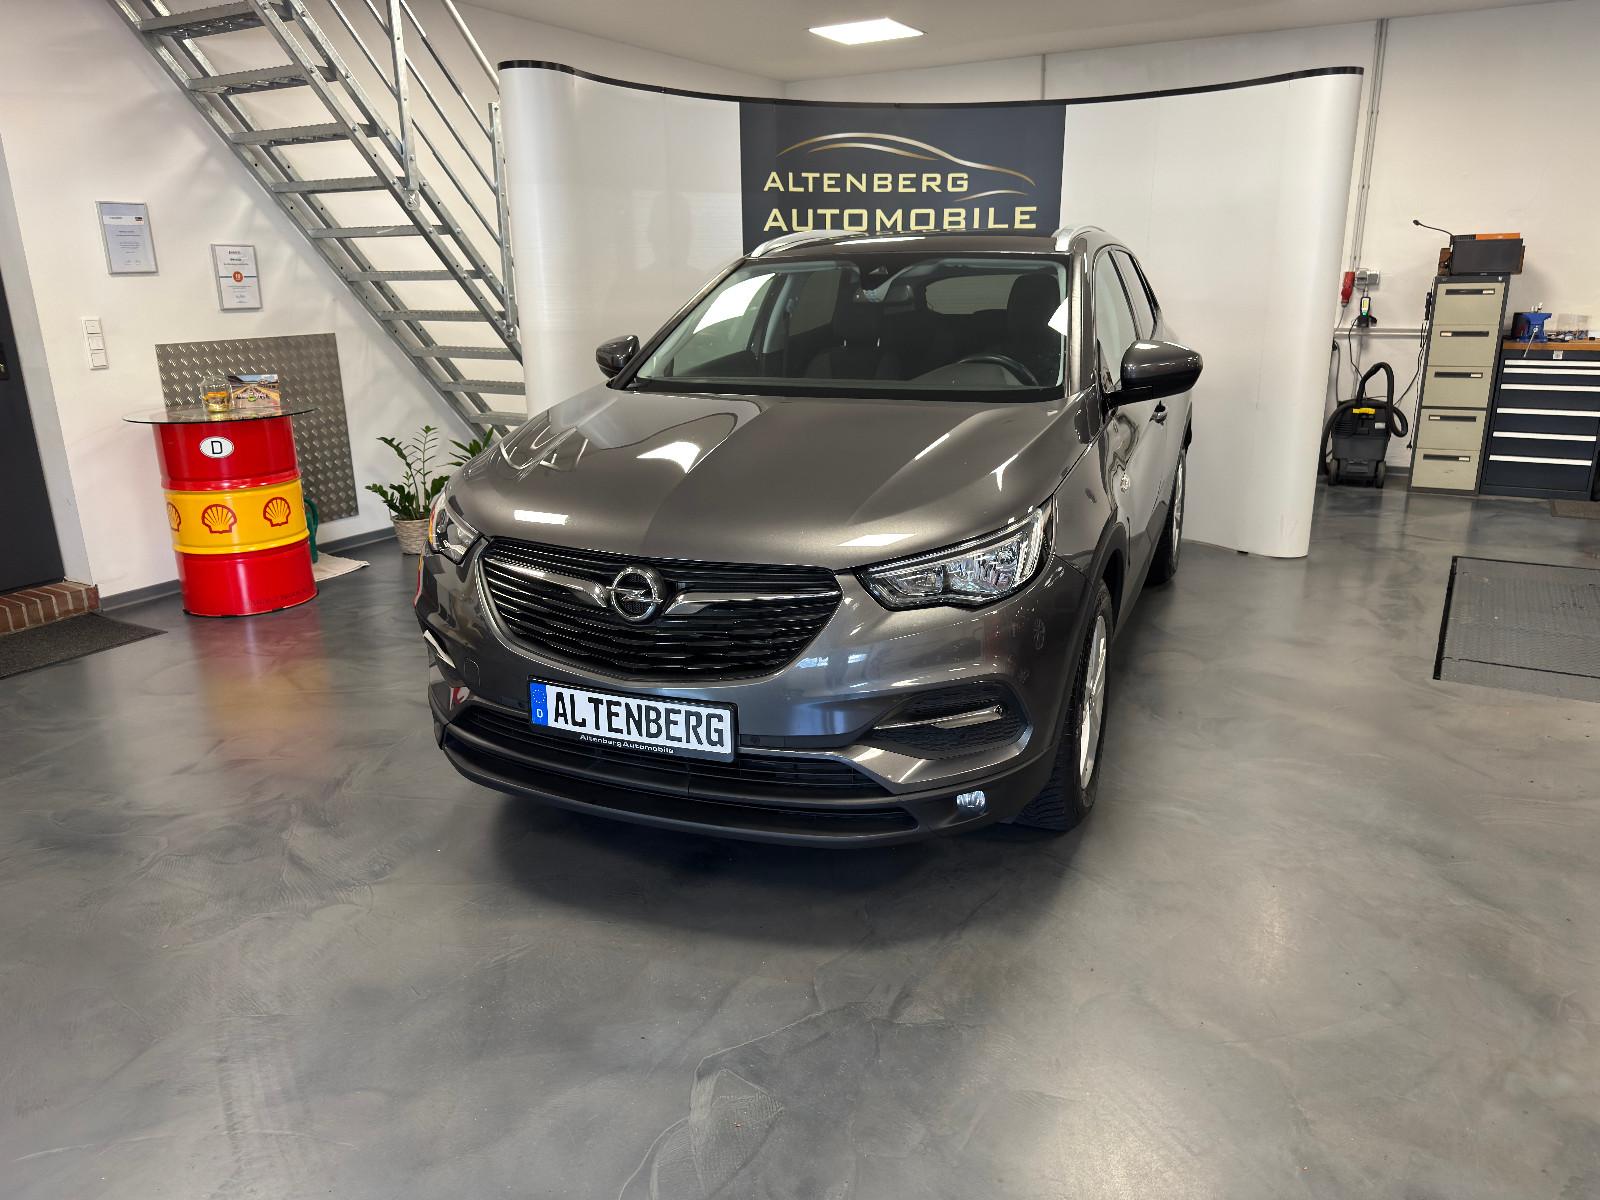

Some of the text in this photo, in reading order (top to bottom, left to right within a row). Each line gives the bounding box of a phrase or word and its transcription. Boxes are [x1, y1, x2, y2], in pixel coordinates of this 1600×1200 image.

[763, 171, 969, 193] ALTENBERG
[763, 206, 1038, 232] AUTOMOBILE
[211, 440, 223, 455] D
[536, 691, 724, 747] D ALTENBERG
